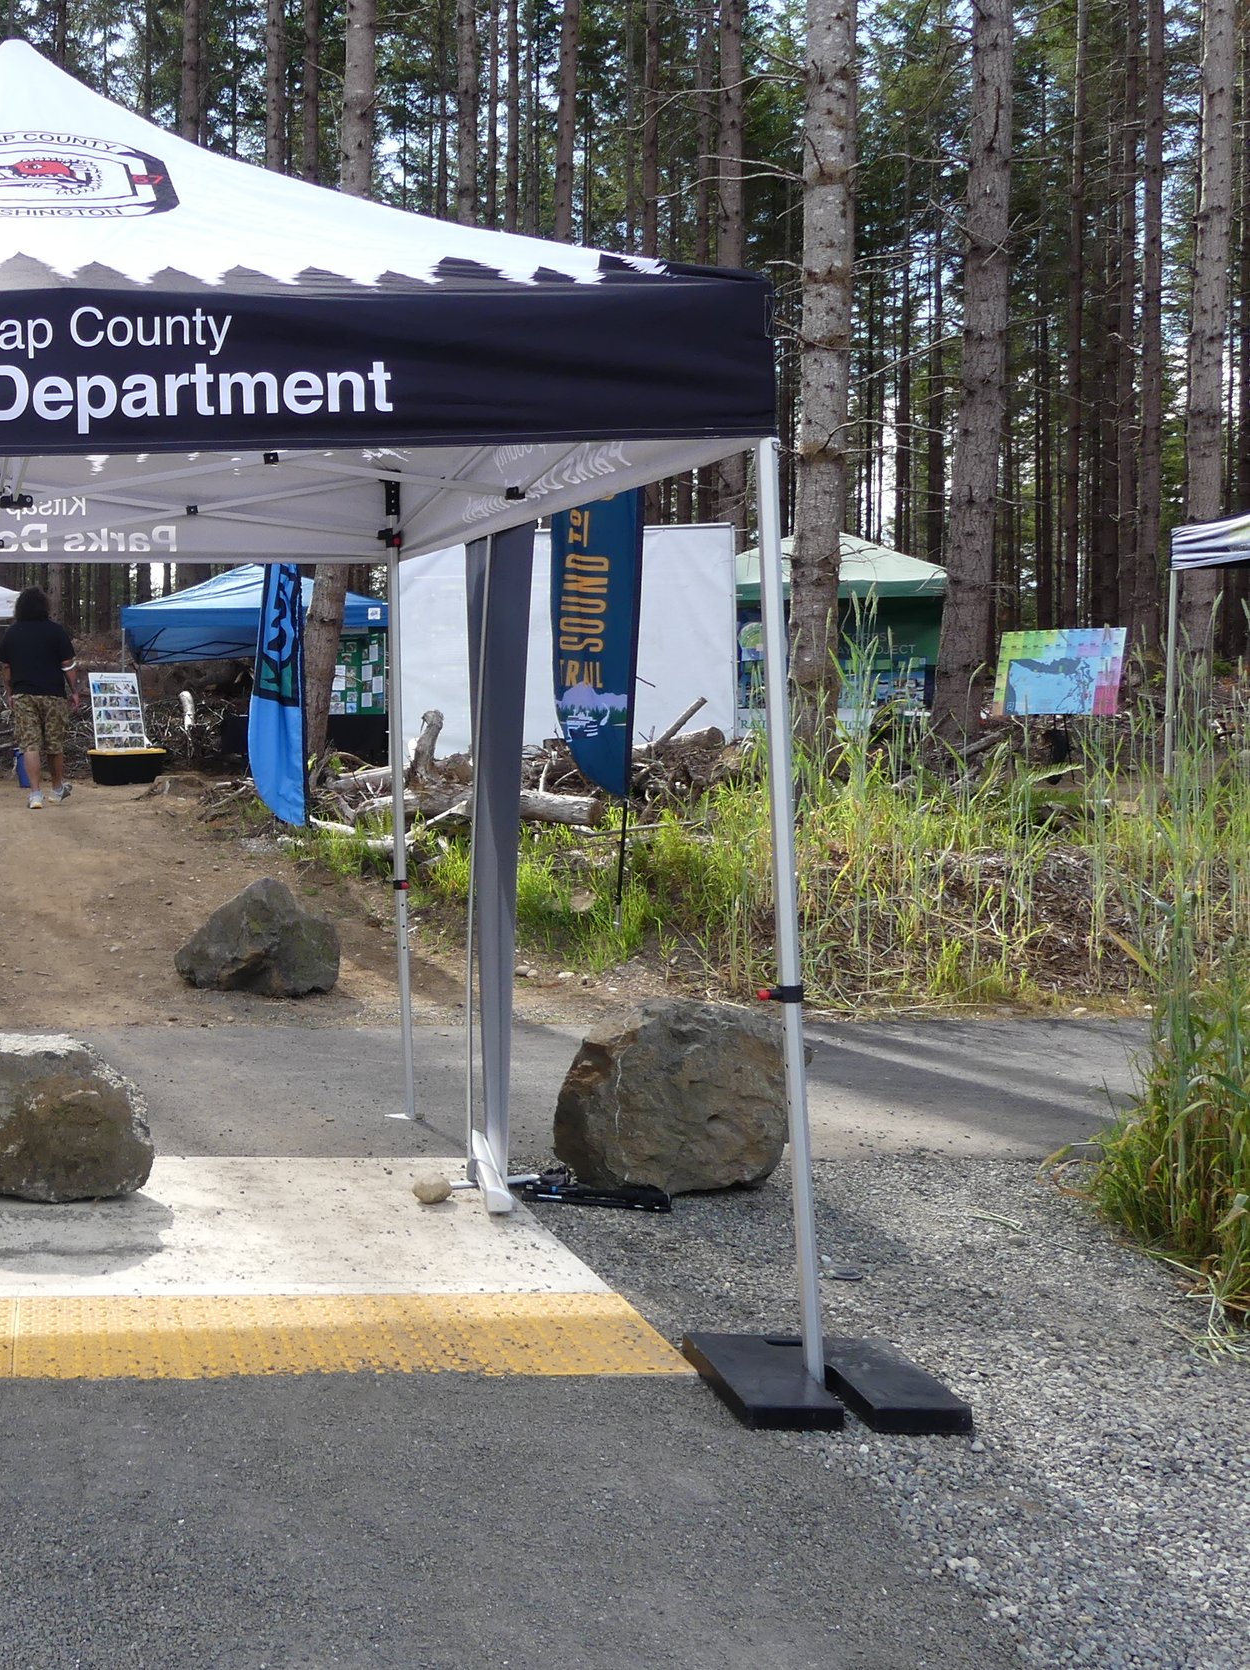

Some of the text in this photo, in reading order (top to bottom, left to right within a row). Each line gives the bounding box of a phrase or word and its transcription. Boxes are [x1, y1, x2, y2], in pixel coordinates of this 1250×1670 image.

[22, 132, 119, 151] COUNTY
[69, 306, 233, 356] County
[559, 553, 610, 653] SOUND
